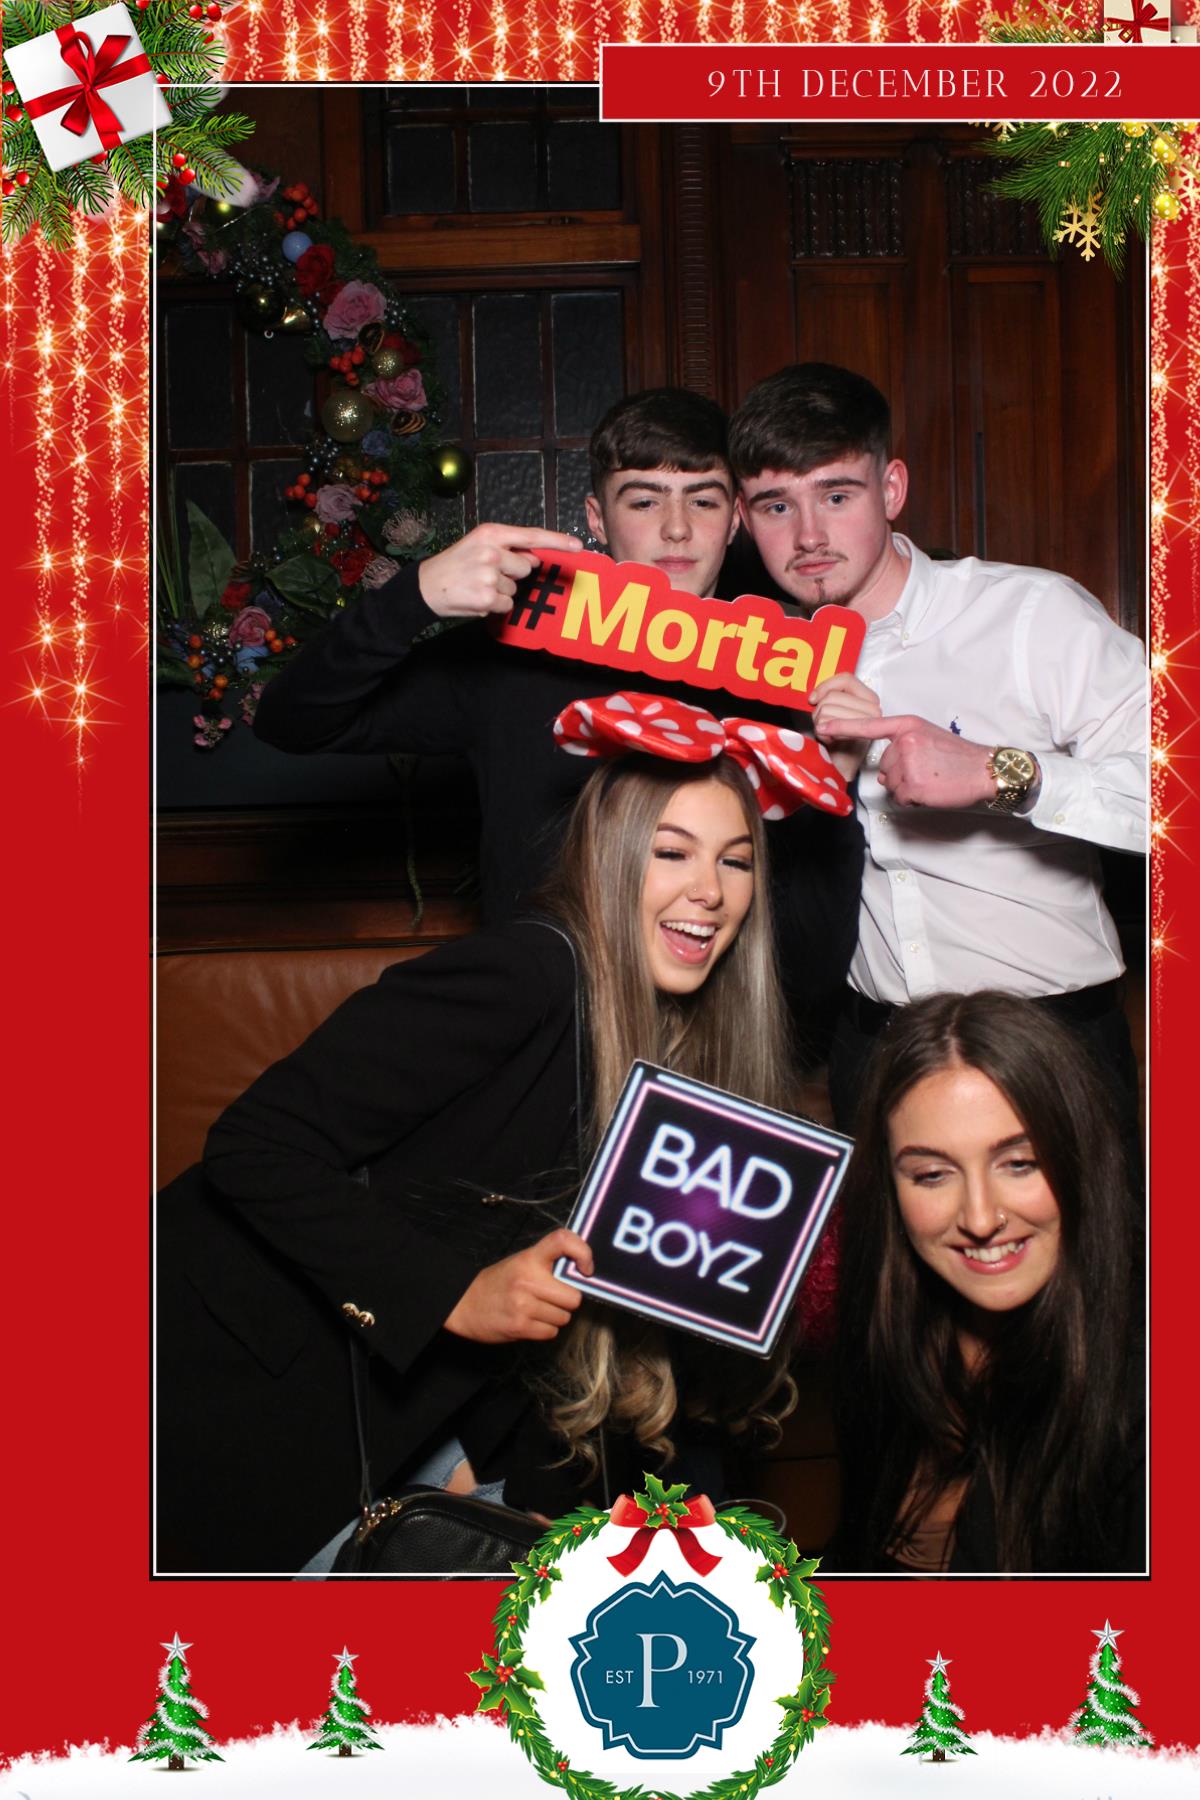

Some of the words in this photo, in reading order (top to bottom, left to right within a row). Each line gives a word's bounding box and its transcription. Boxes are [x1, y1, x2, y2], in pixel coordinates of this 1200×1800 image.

[507, 560, 848, 693] #Mortal
[640, 1123, 793, 1220] BAD
[612, 1205, 763, 1293] BOYZ
